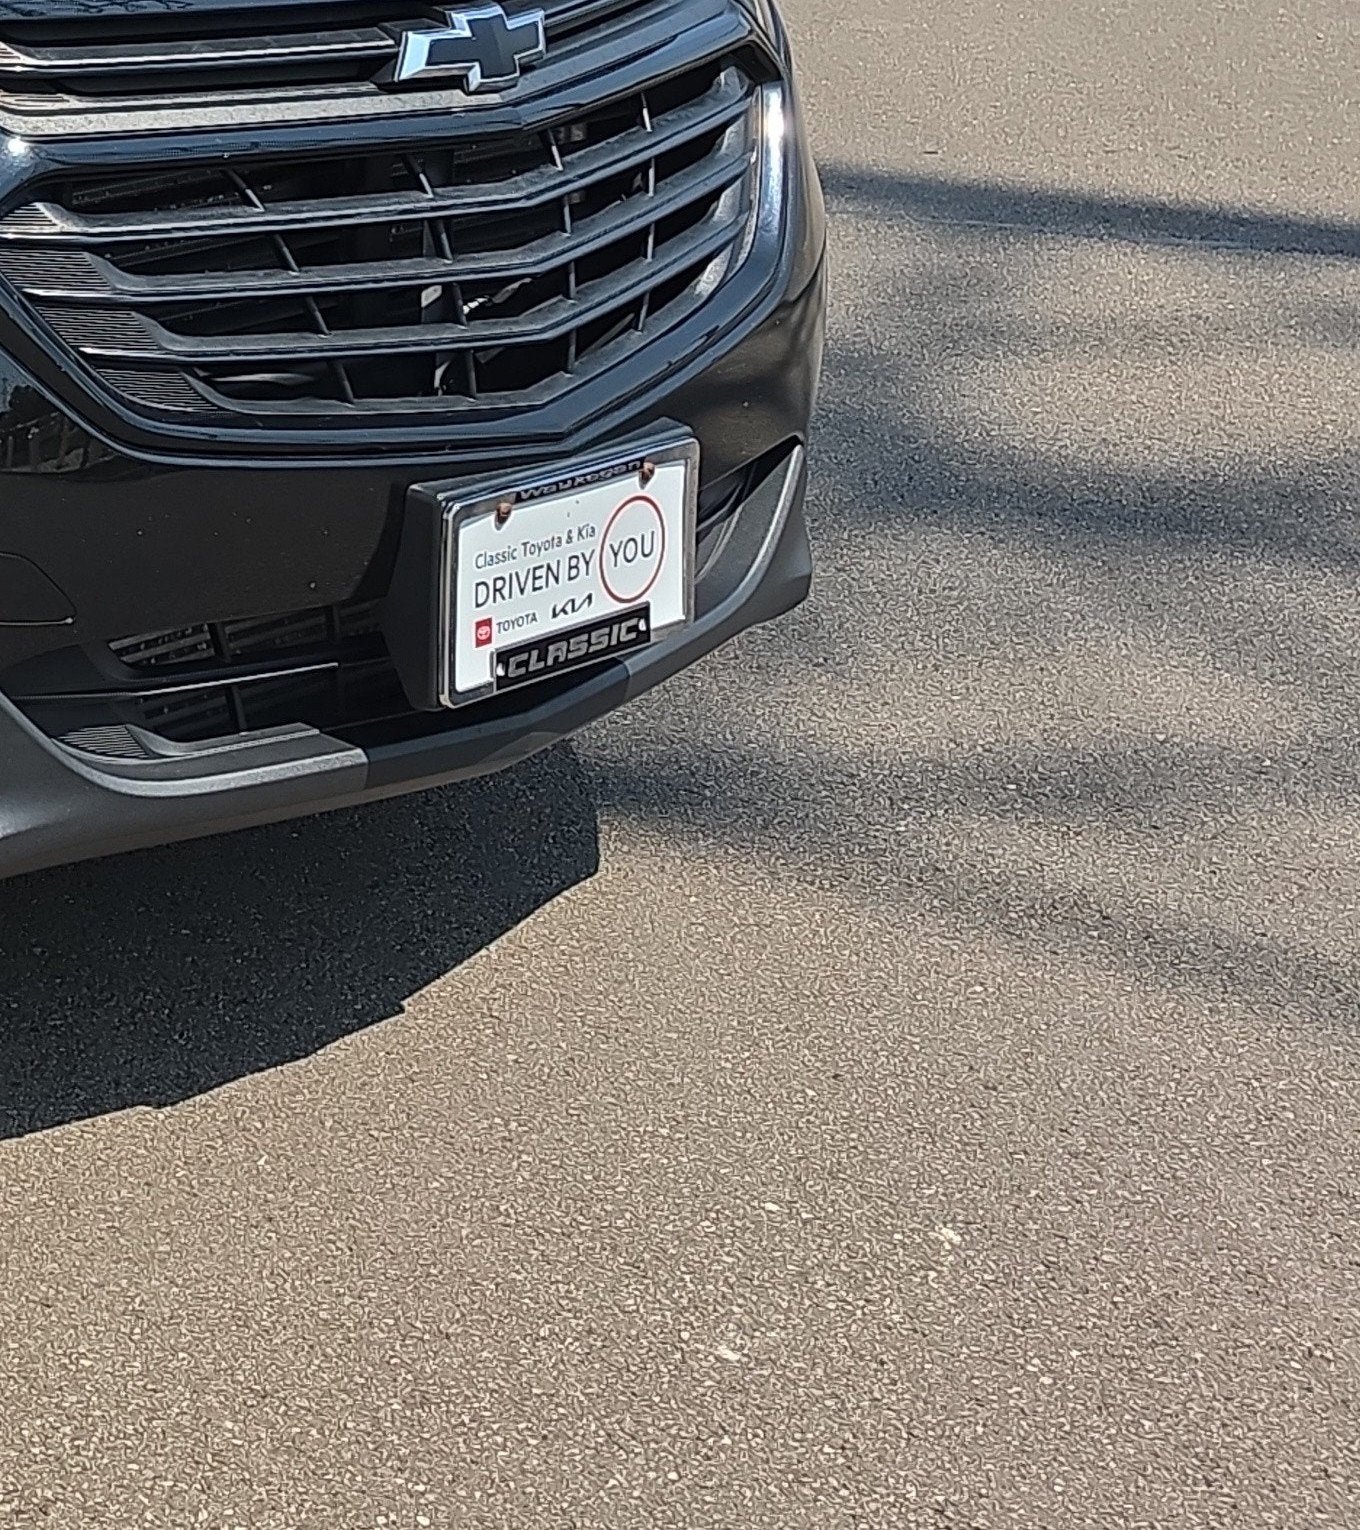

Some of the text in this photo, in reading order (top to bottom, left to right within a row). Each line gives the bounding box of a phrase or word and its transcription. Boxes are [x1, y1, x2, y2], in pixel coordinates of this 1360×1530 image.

[474, 530, 655, 609] DRIVEN BY YOU
[475, 523, 596, 569] Classic Toyota & Kia
[496, 611, 538, 635] TOYOTA
[506, 617, 639, 678] CLASSIC
